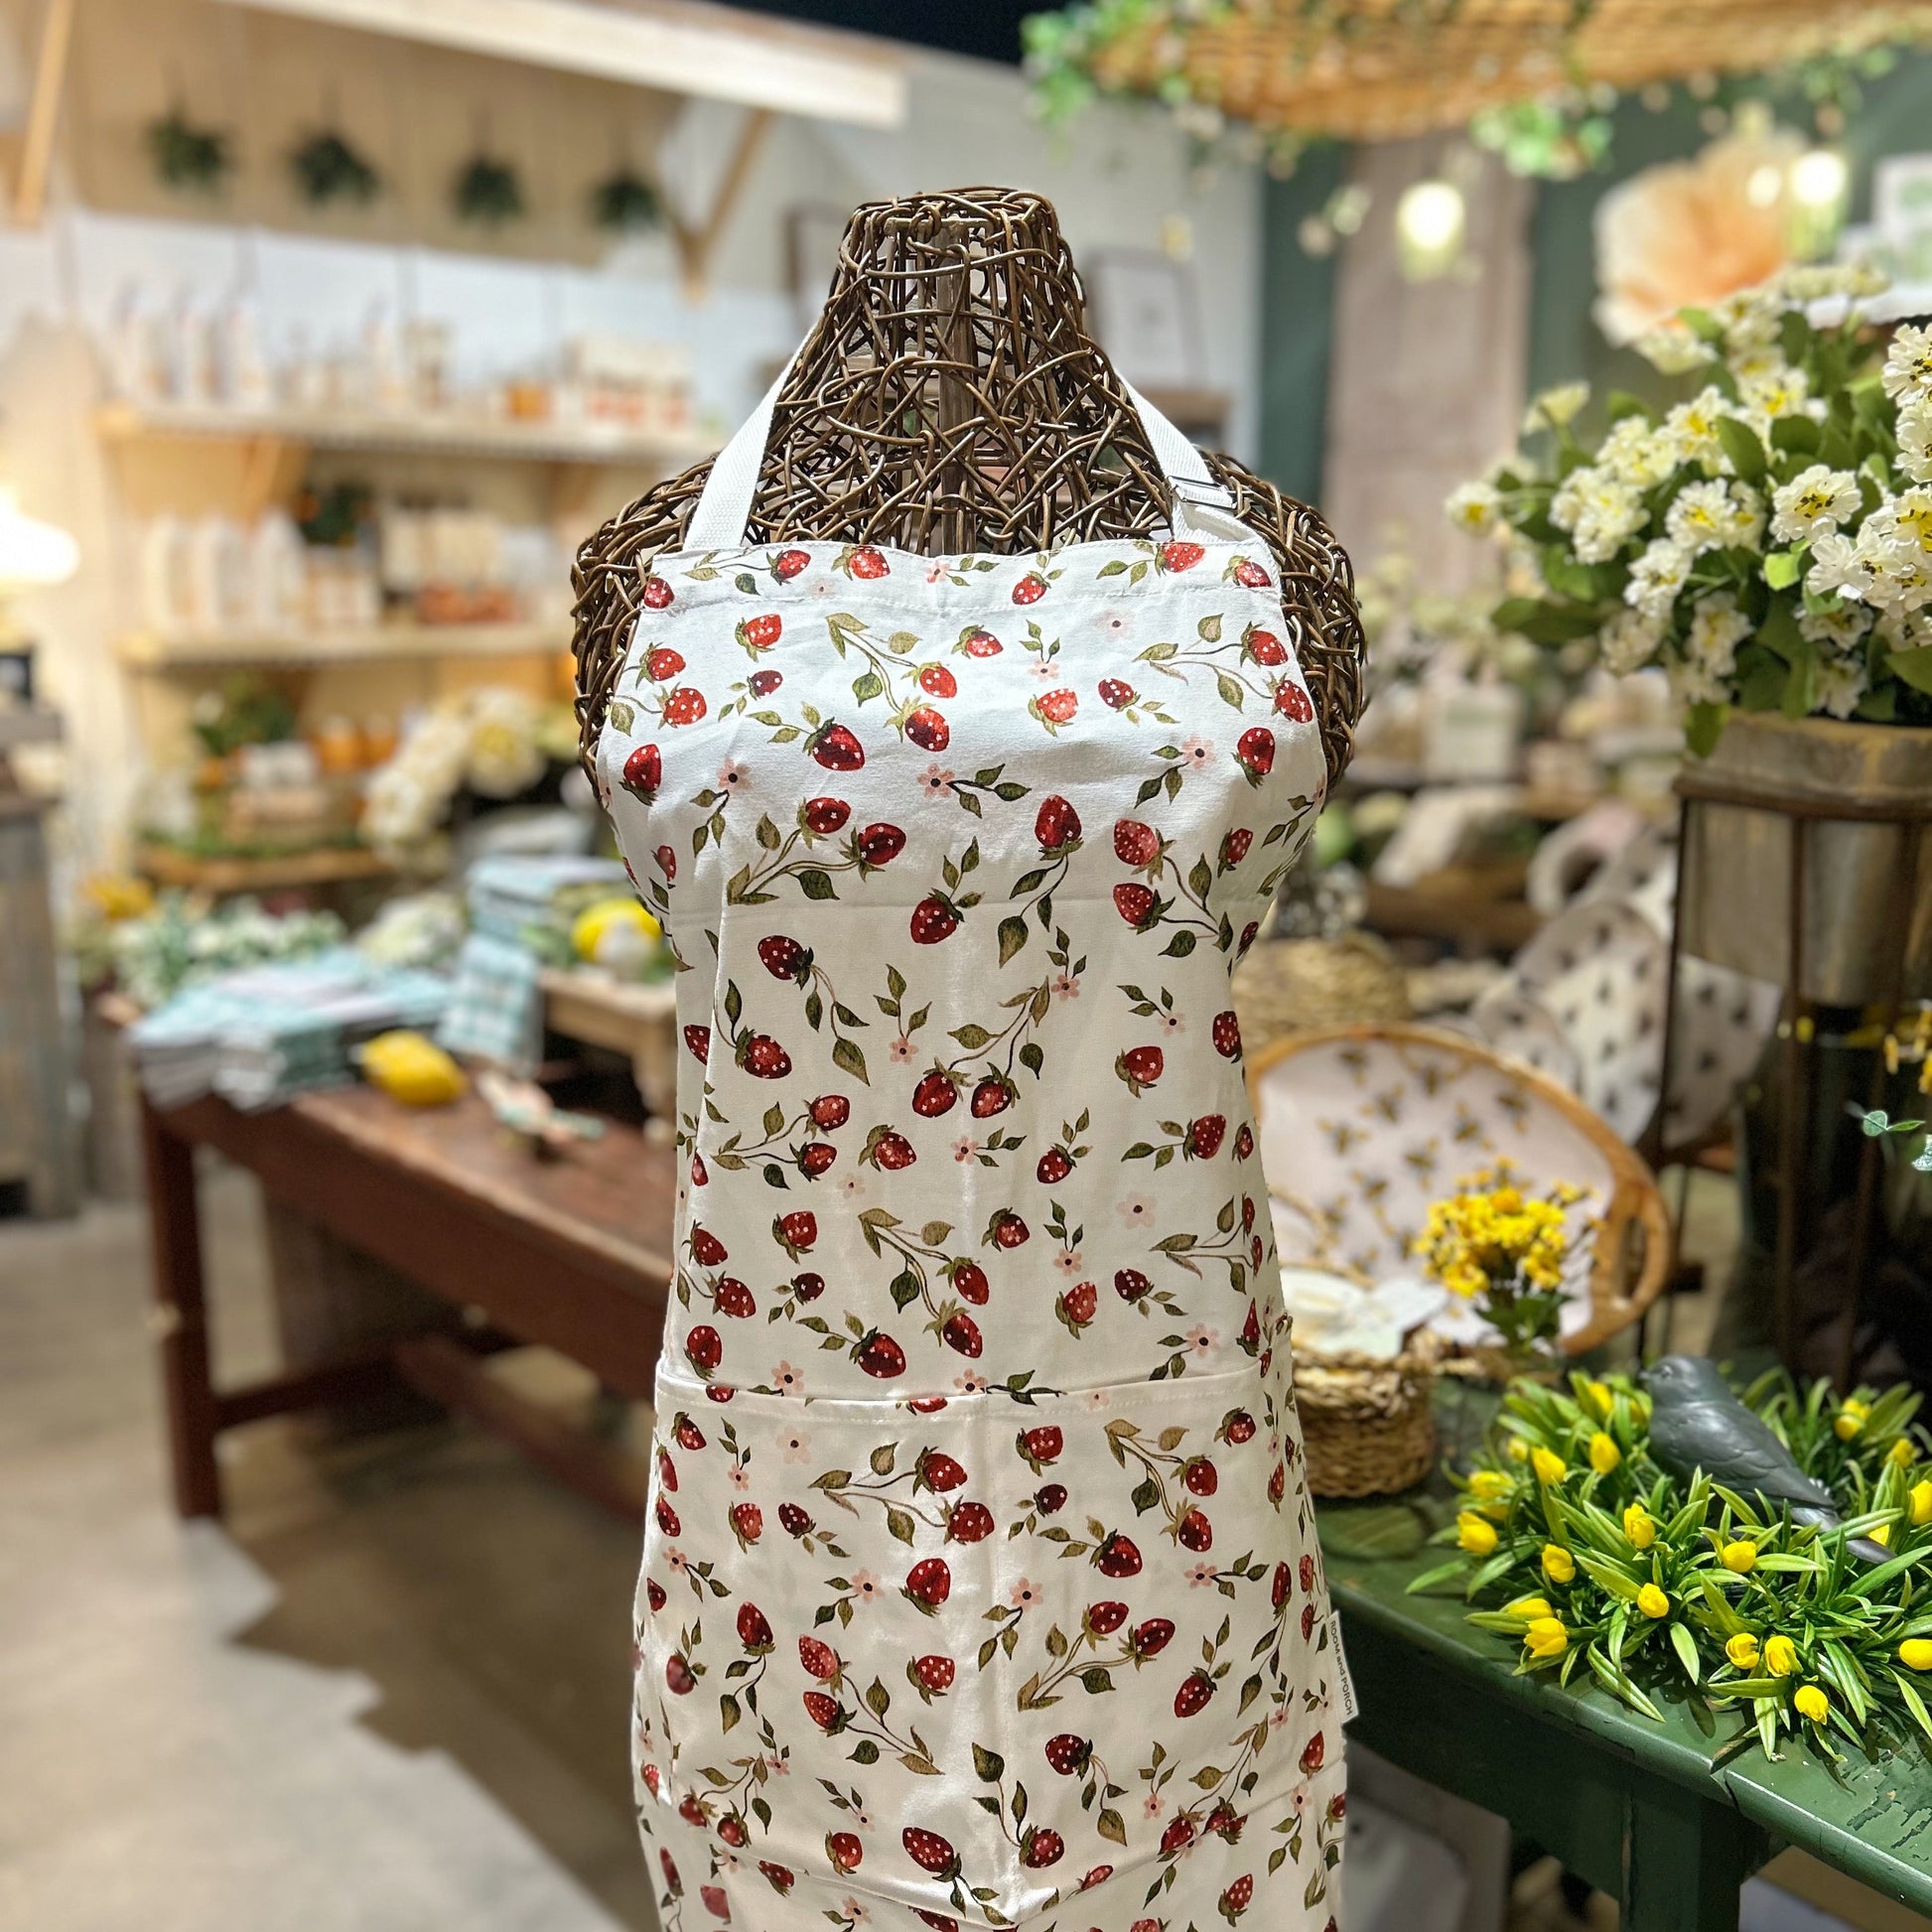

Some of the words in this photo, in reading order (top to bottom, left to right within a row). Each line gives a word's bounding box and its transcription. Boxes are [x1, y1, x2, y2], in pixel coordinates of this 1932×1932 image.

[1330, 1620, 1341, 1654] ROOM
[1336, 1656, 1345, 1676] and
[1340, 1677, 1353, 1716] PORCH
